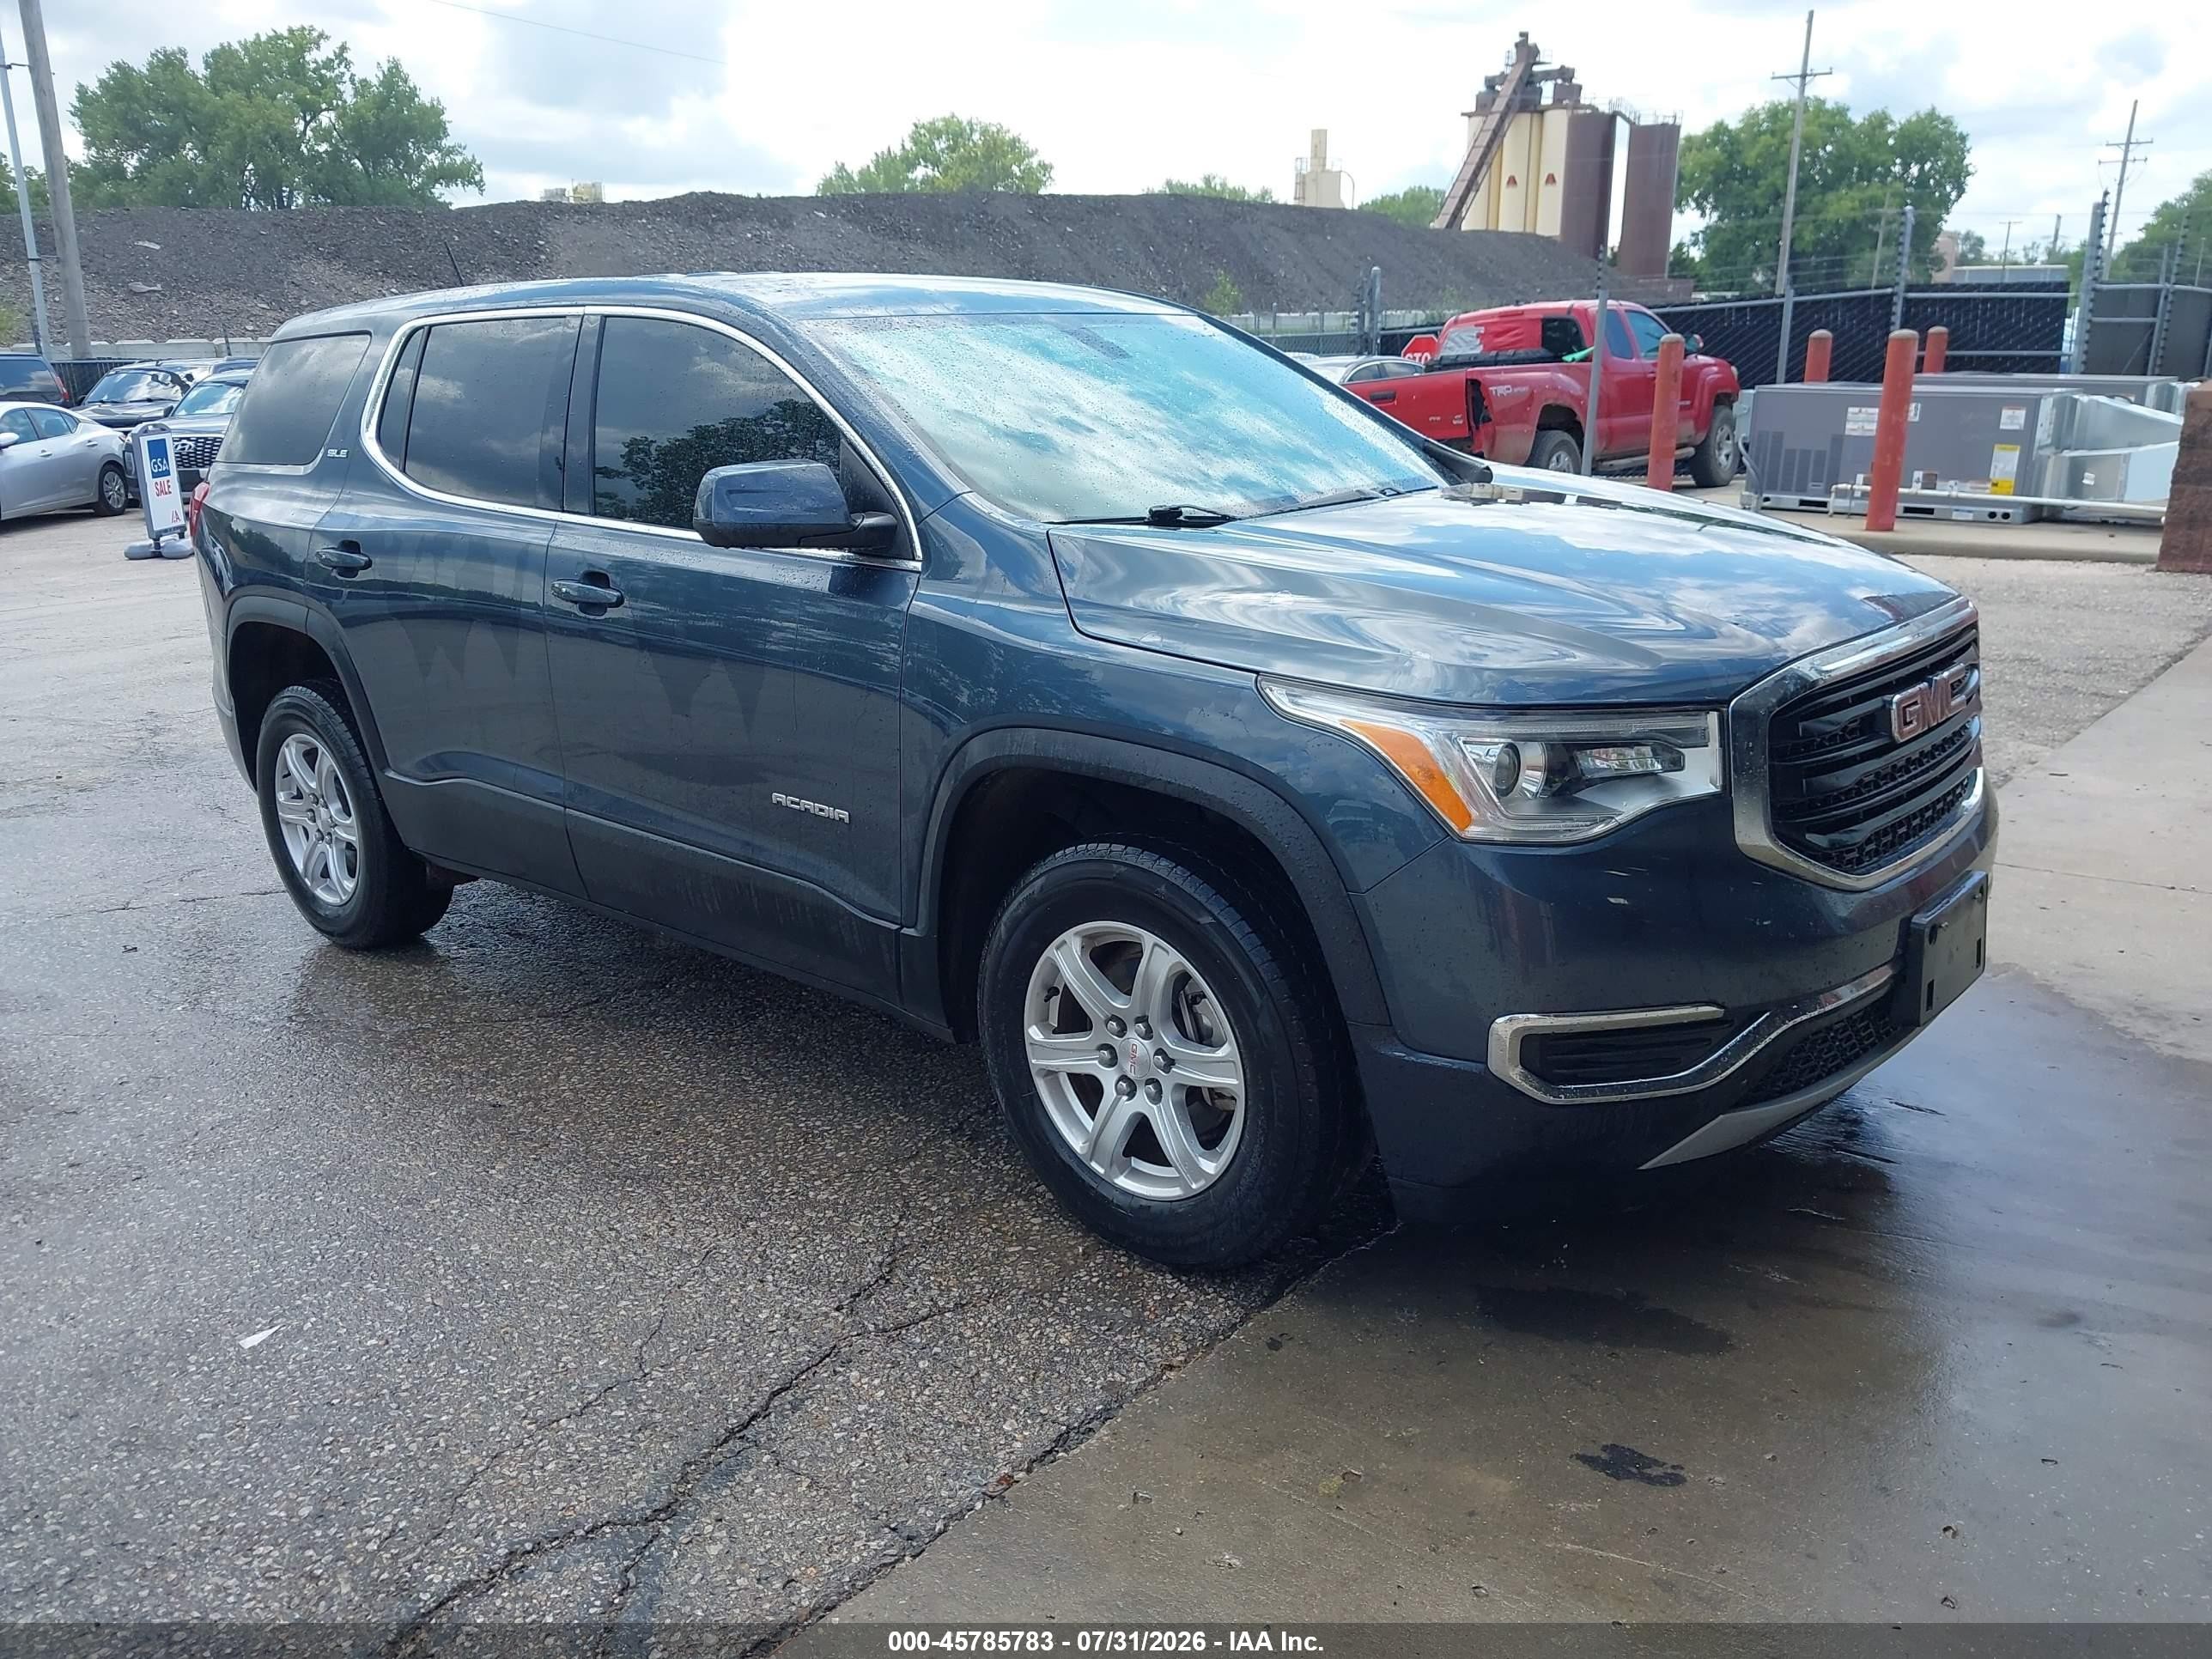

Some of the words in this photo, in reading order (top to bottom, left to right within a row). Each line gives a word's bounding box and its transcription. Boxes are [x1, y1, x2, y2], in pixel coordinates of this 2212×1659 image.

[150, 457, 169, 473] GSA
[327, 448, 348, 458] SLE
[155, 479, 173, 497] SALE
[1891, 663, 1967, 742] GMC
[771, 792, 850, 824] ACADIA
[1129, 1042, 1138, 1075] GMC
